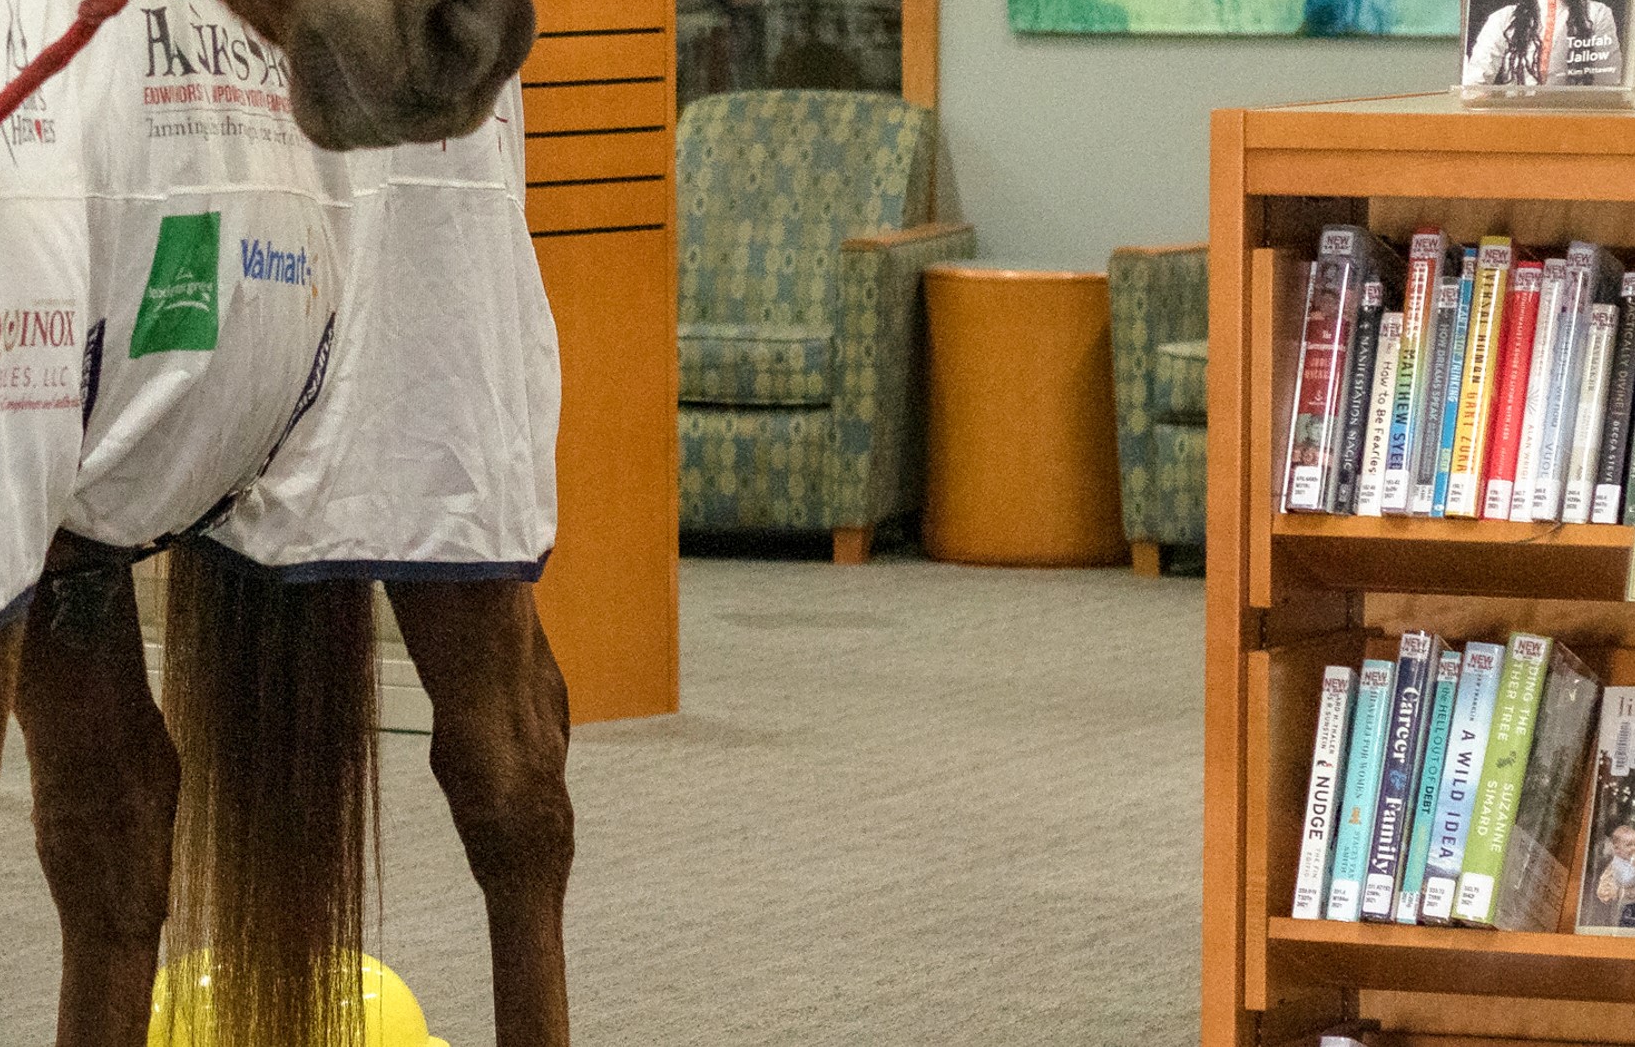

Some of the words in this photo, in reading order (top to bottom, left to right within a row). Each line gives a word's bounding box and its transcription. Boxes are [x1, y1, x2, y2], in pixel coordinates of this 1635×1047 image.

[1566, 34, 1612, 49] Toufah
[1566, 51, 1610, 63] Jallow
[1327, 235, 1349, 245] NEW
[1417, 238, 1439, 248] NEW
[1485, 250, 1508, 260] NEW
[1569, 253, 1592, 263] NEW
[1518, 273, 1543, 282] NEW
[1479, 268, 1497, 325] IVERSAL
[1593, 311, 1615, 322] NEW
[1438, 324, 1449, 347] HOW
[1432, 350, 1445, 389] DREAMS
[1472, 335, 1488, 384] HUMAN
[1349, 336, 1373, 425] MANIFESTATION
[1380, 362, 1392, 386] How
[1395, 349, 1416, 425] MATTHEW
[1448, 360, 1463, 403] THINKING
[1378, 392, 1388, 404] to
[1507, 380, 1516, 404] LIVING
[1615, 370, 1628, 408] DIVINE
[1376, 409, 1386, 424] Be
[1429, 391, 1440, 420] SPEAK
[1504, 406, 1512, 423] WITH
[1502, 424, 1510, 440] LESS
[1525, 424, 1535, 448] ALAN
[1609, 421, 1620, 451] BECCA
[1343, 430, 1358, 470] MAGIC
[1457, 436, 1473, 473] ZUKA
[1605, 455, 1616, 483] STEVE
[1404, 638, 1426, 648] NEW
[1518, 640, 1542, 650] NEW
[1470, 655, 1493, 665] NEW
[1325, 679, 1347, 688] NEW
[1365, 672, 1387, 681] NEW
[1523, 664, 1540, 703] DING
[1440, 687, 1451, 703] the
[1321, 711, 1331, 750] SUNSTEIN
[1391, 686, 1419, 763] Career
[1435, 704, 1448, 734] HELL
[1497, 704, 1514, 741] TREE
[1515, 708, 1530, 736] THE
[1328, 724, 1338, 754] THALER
[1361, 739, 1370, 759] FOR
[1430, 736, 1442, 762] OUT
[1461, 730, 1475, 742] A
[1356, 762, 1367, 799] WOMEN
[1389, 769, 1407, 791] &
[1426, 766, 1437, 783] OF
[1450, 750, 1472, 802] WILD
[1309, 776, 1330, 841] NUDGE
[1421, 786, 1434, 814] DEBT
[1477, 780, 1498, 836] SIMARD
[1490, 783, 1514, 853] SUZANNE
[1350, 831, 1360, 860] STACEY
[1371, 796, 1402, 874] Family
[1439, 812, 1460, 860] IDEA
[1303, 852, 1312, 878] EDITIO
[1340, 846, 1350, 873] SMITH
[1348, 863, 1356, 879] VAN
